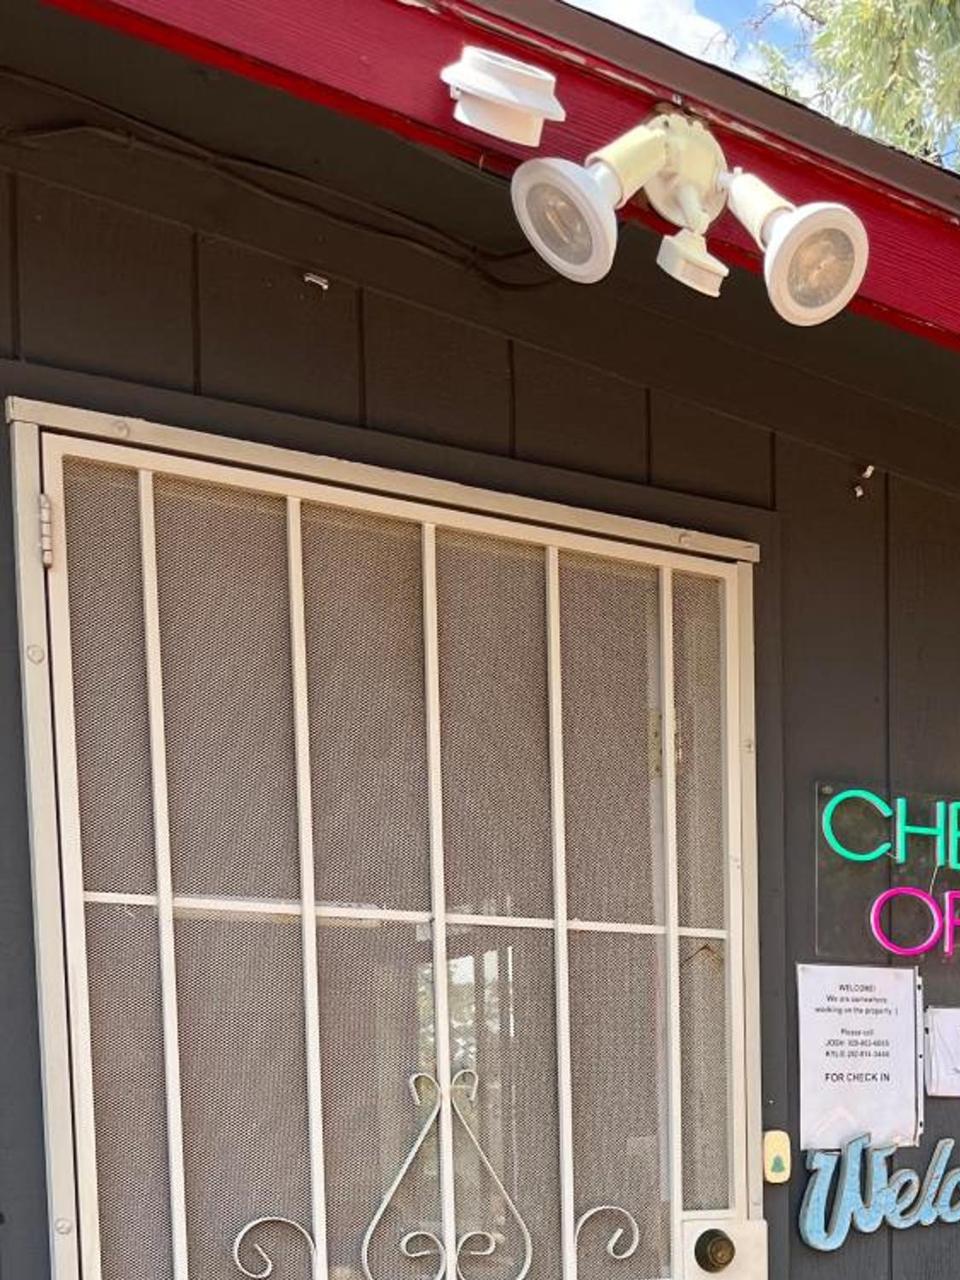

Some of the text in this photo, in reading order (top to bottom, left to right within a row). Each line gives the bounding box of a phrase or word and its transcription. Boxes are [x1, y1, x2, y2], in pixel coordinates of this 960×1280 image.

[824, 1072, 891, 1083] FOR CHECK IN
